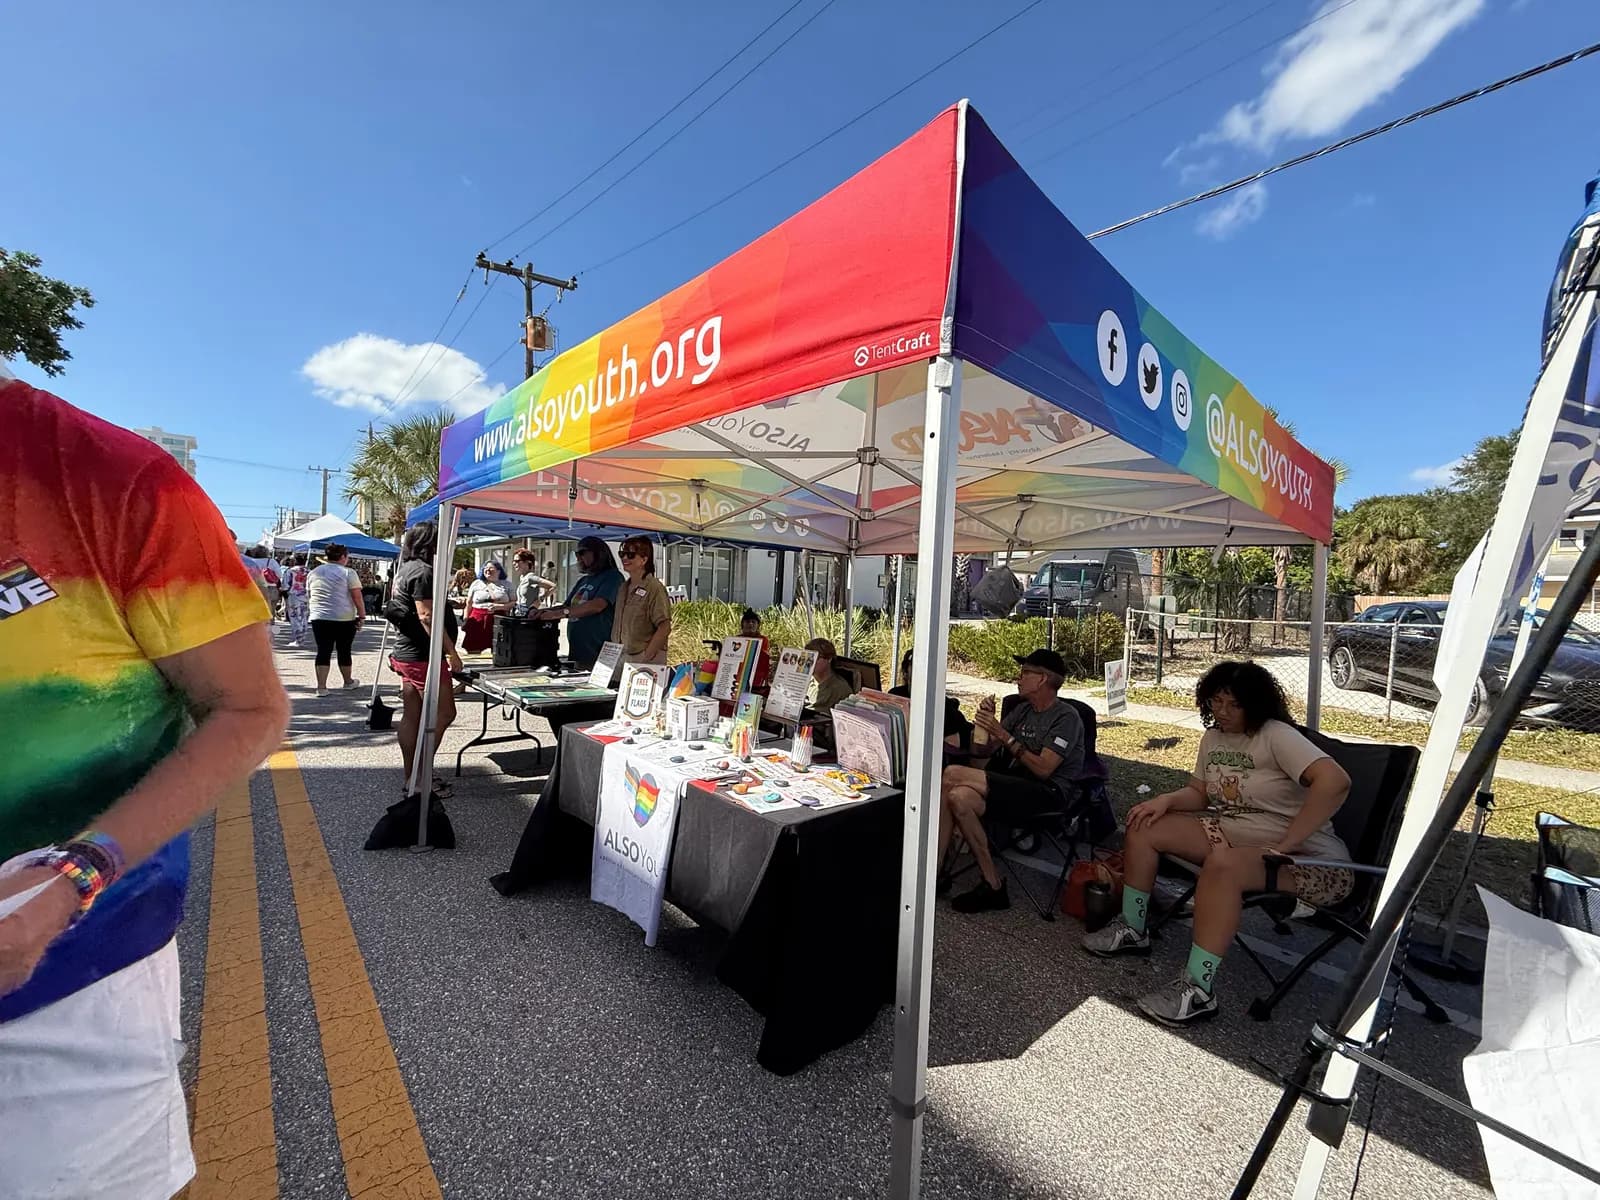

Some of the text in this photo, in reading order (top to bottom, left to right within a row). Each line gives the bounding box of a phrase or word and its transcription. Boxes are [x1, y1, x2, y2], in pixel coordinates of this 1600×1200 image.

[871, 332, 931, 359] TentCraft
[474, 316, 722, 463] www.alsoyouth.org
[1206, 393, 1312, 511] @ALSOYOUTH
[636, 678, 649, 686] FREE
[632, 688, 649, 697] PRIDE
[630, 699, 647, 708] FLAGS
